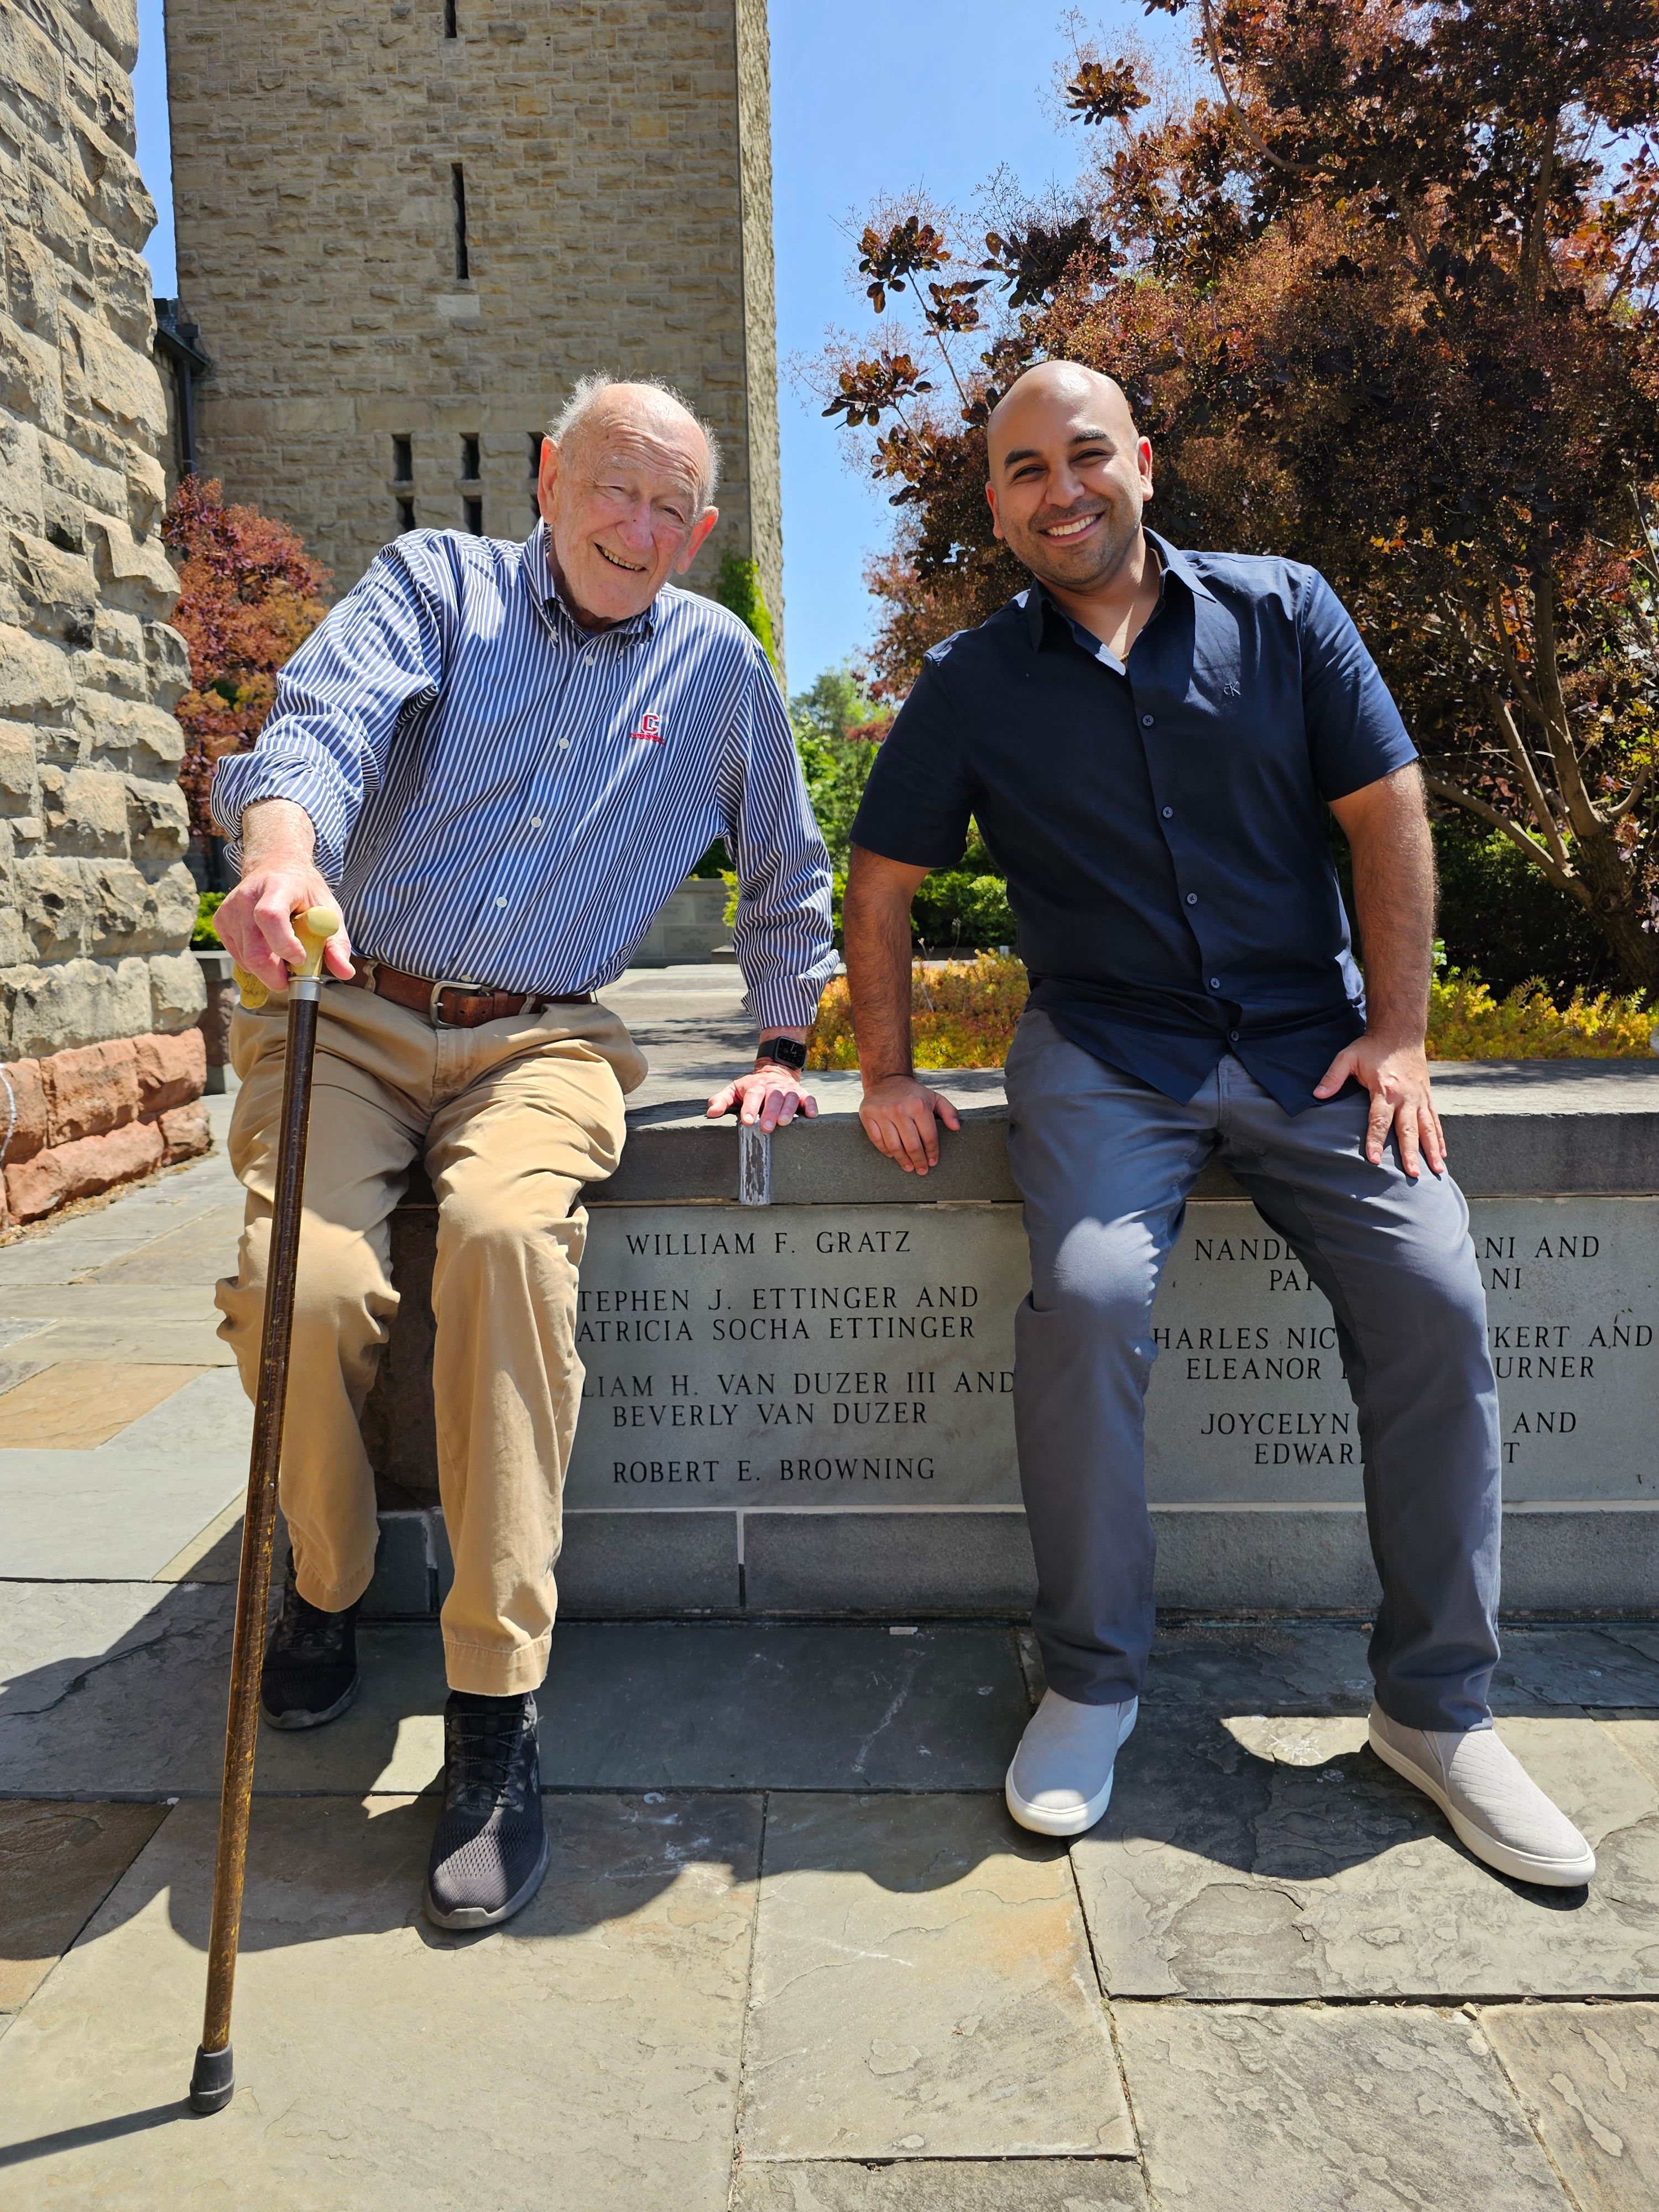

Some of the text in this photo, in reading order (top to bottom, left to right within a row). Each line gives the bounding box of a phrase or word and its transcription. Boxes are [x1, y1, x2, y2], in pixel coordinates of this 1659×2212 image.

[641, 712, 660, 734] C
[625, 1230, 910, 1255] WILLIAM F. GRATZ
[1534, 1236, 1599, 1258] AND
[578, 1286, 978, 1312] TEPHEN J. ETTINGER AND
[577, 1316, 975, 1342] ATRICIA SOCHA ETTINGER
[1153, 1326, 1652, 1350] HARLES NIC KERT AND
[1186, 1357, 1322, 1380] ELEANOR
[1495, 1356, 1594, 1379] URNER
[582, 1371, 1014, 1398] LIAM H. VAN DUZER III AND
[612, 1402, 927, 1427] BEVERLY VAN DUZER
[1201, 1411, 1576, 1435] JOYCELYN AND
[613, 1457, 934, 1484] ROBERT E. BROWNING
